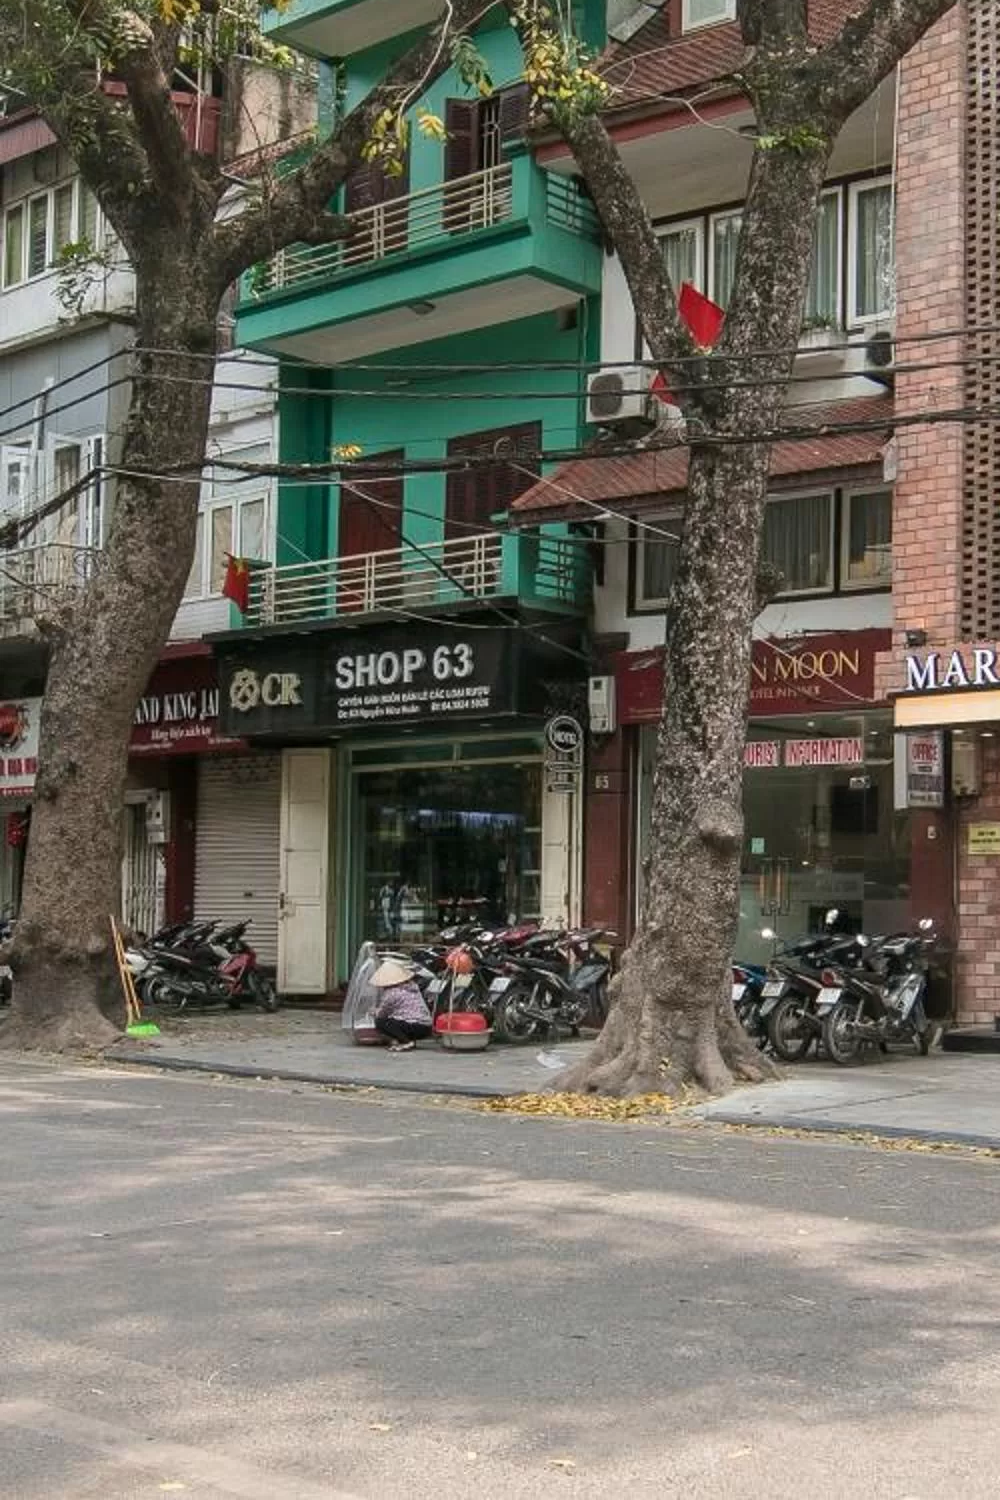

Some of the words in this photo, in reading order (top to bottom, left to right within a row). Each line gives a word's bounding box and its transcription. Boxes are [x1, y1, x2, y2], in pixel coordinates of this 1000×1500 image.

[335, 649, 425, 689] SHOP
[433, 643, 474, 680] 63
[775, 648, 859, 681] MOON
[164, 692, 197, 721] KING
[788, 739, 861, 765] INFORMATION
